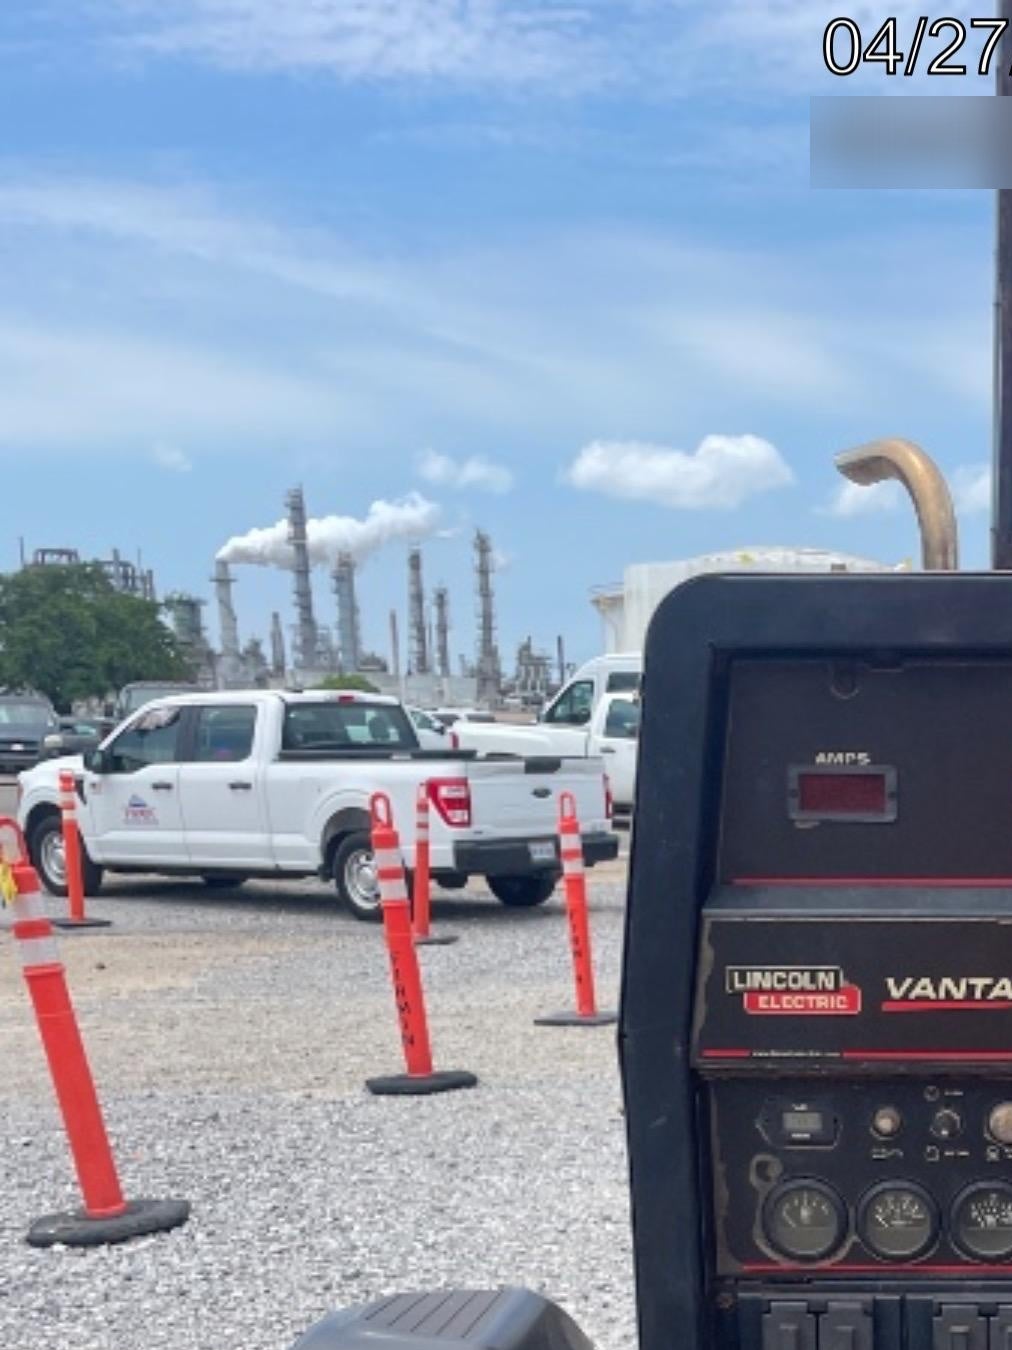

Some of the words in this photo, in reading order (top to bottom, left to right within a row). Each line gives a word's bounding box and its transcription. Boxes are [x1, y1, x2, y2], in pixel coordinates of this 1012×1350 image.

[815, 752, 871, 766] AMPS
[732, 971, 836, 990] LINCOLN
[757, 995, 848, 1010] ELECTRIC
